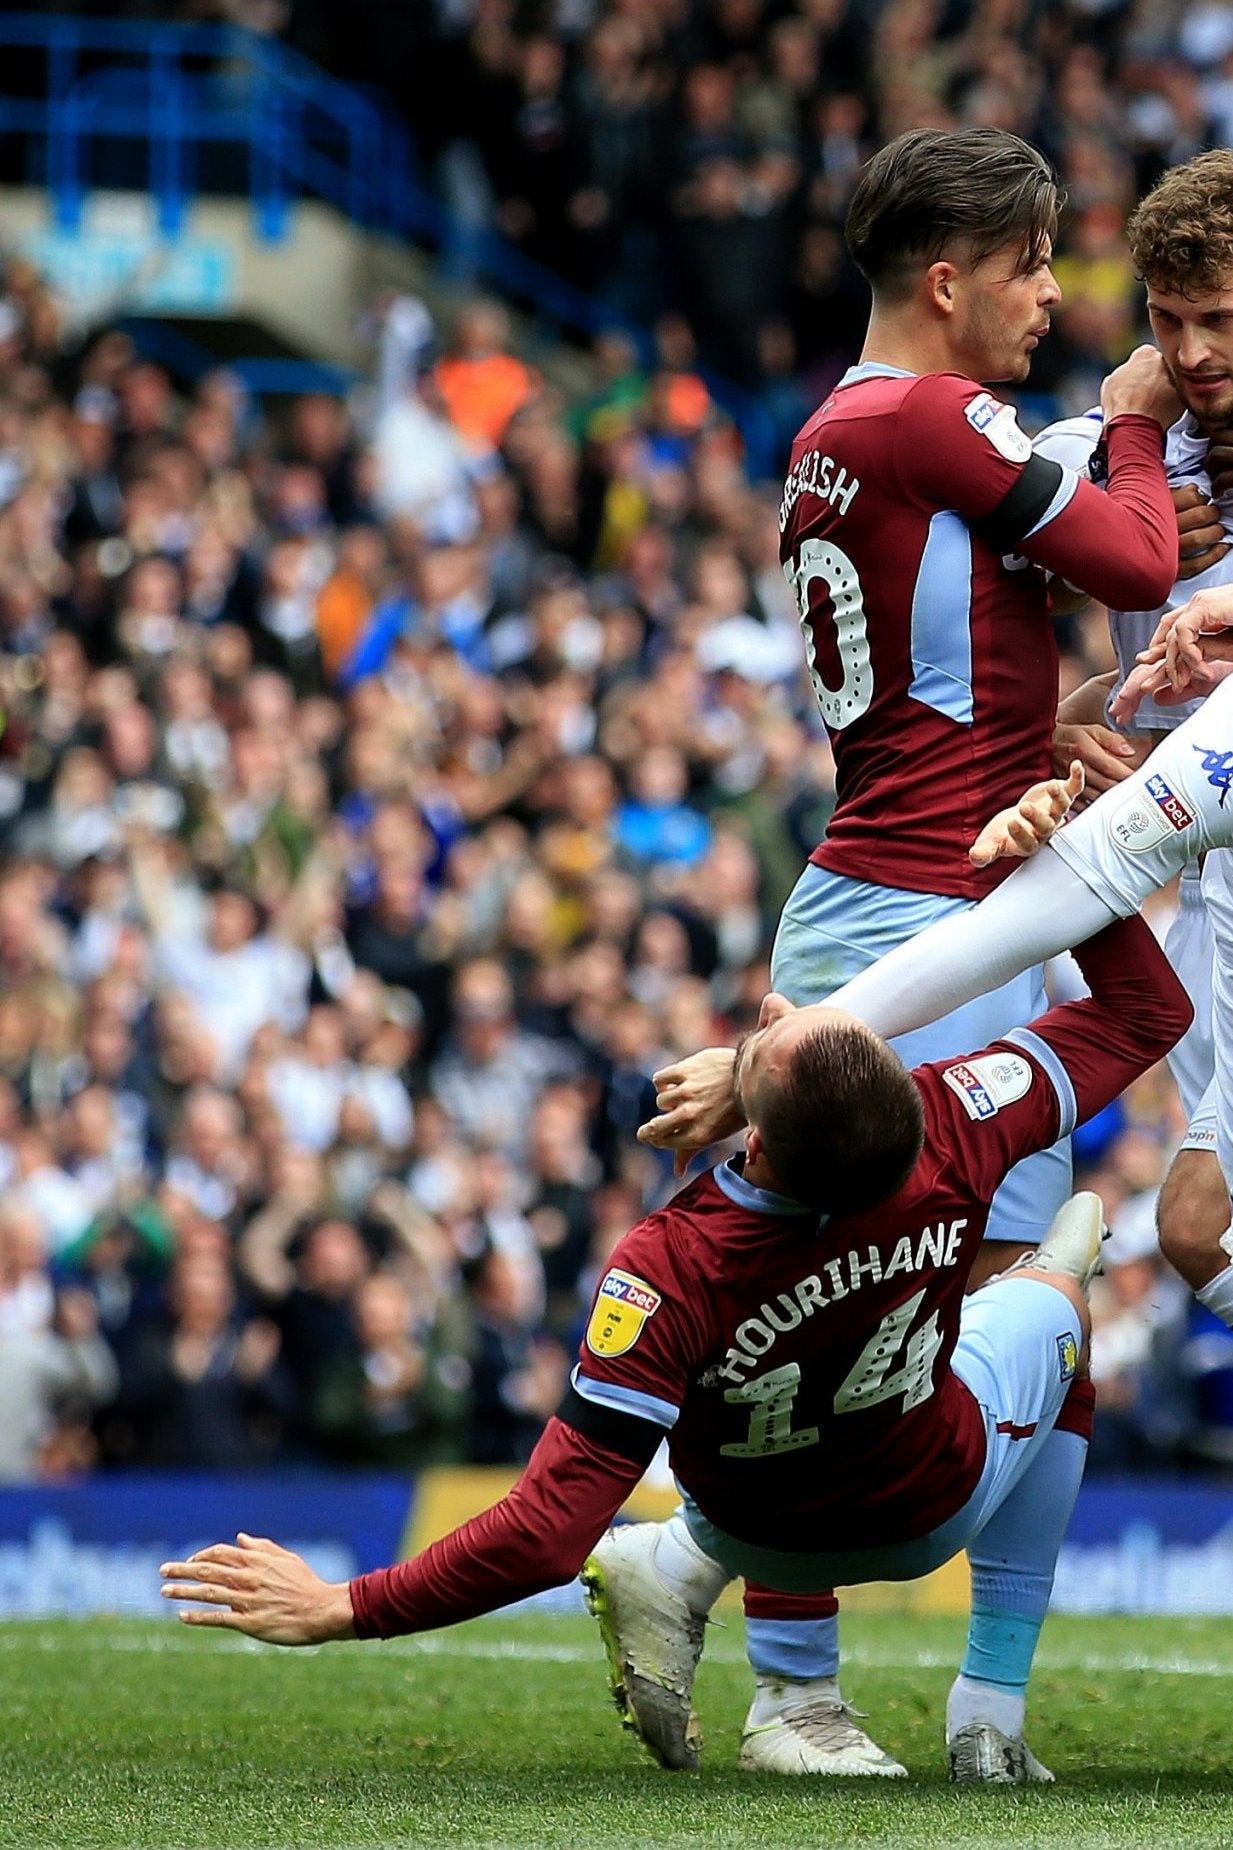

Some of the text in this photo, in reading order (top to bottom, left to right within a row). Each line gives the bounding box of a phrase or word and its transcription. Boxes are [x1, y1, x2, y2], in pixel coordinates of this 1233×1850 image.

[782, 538, 874, 729] 0
[1148, 777, 1169, 800] sky
[1164, 798, 1189, 827] bet
[1116, 824, 1132, 843] EFL
[952, 1065, 977, 1089] bet
[970, 1088, 992, 1114] sky
[603, 1279, 655, 1311] sky bet
[720, 1218, 968, 1383] HOURIHANE
[720, 1287, 945, 1459] 14
